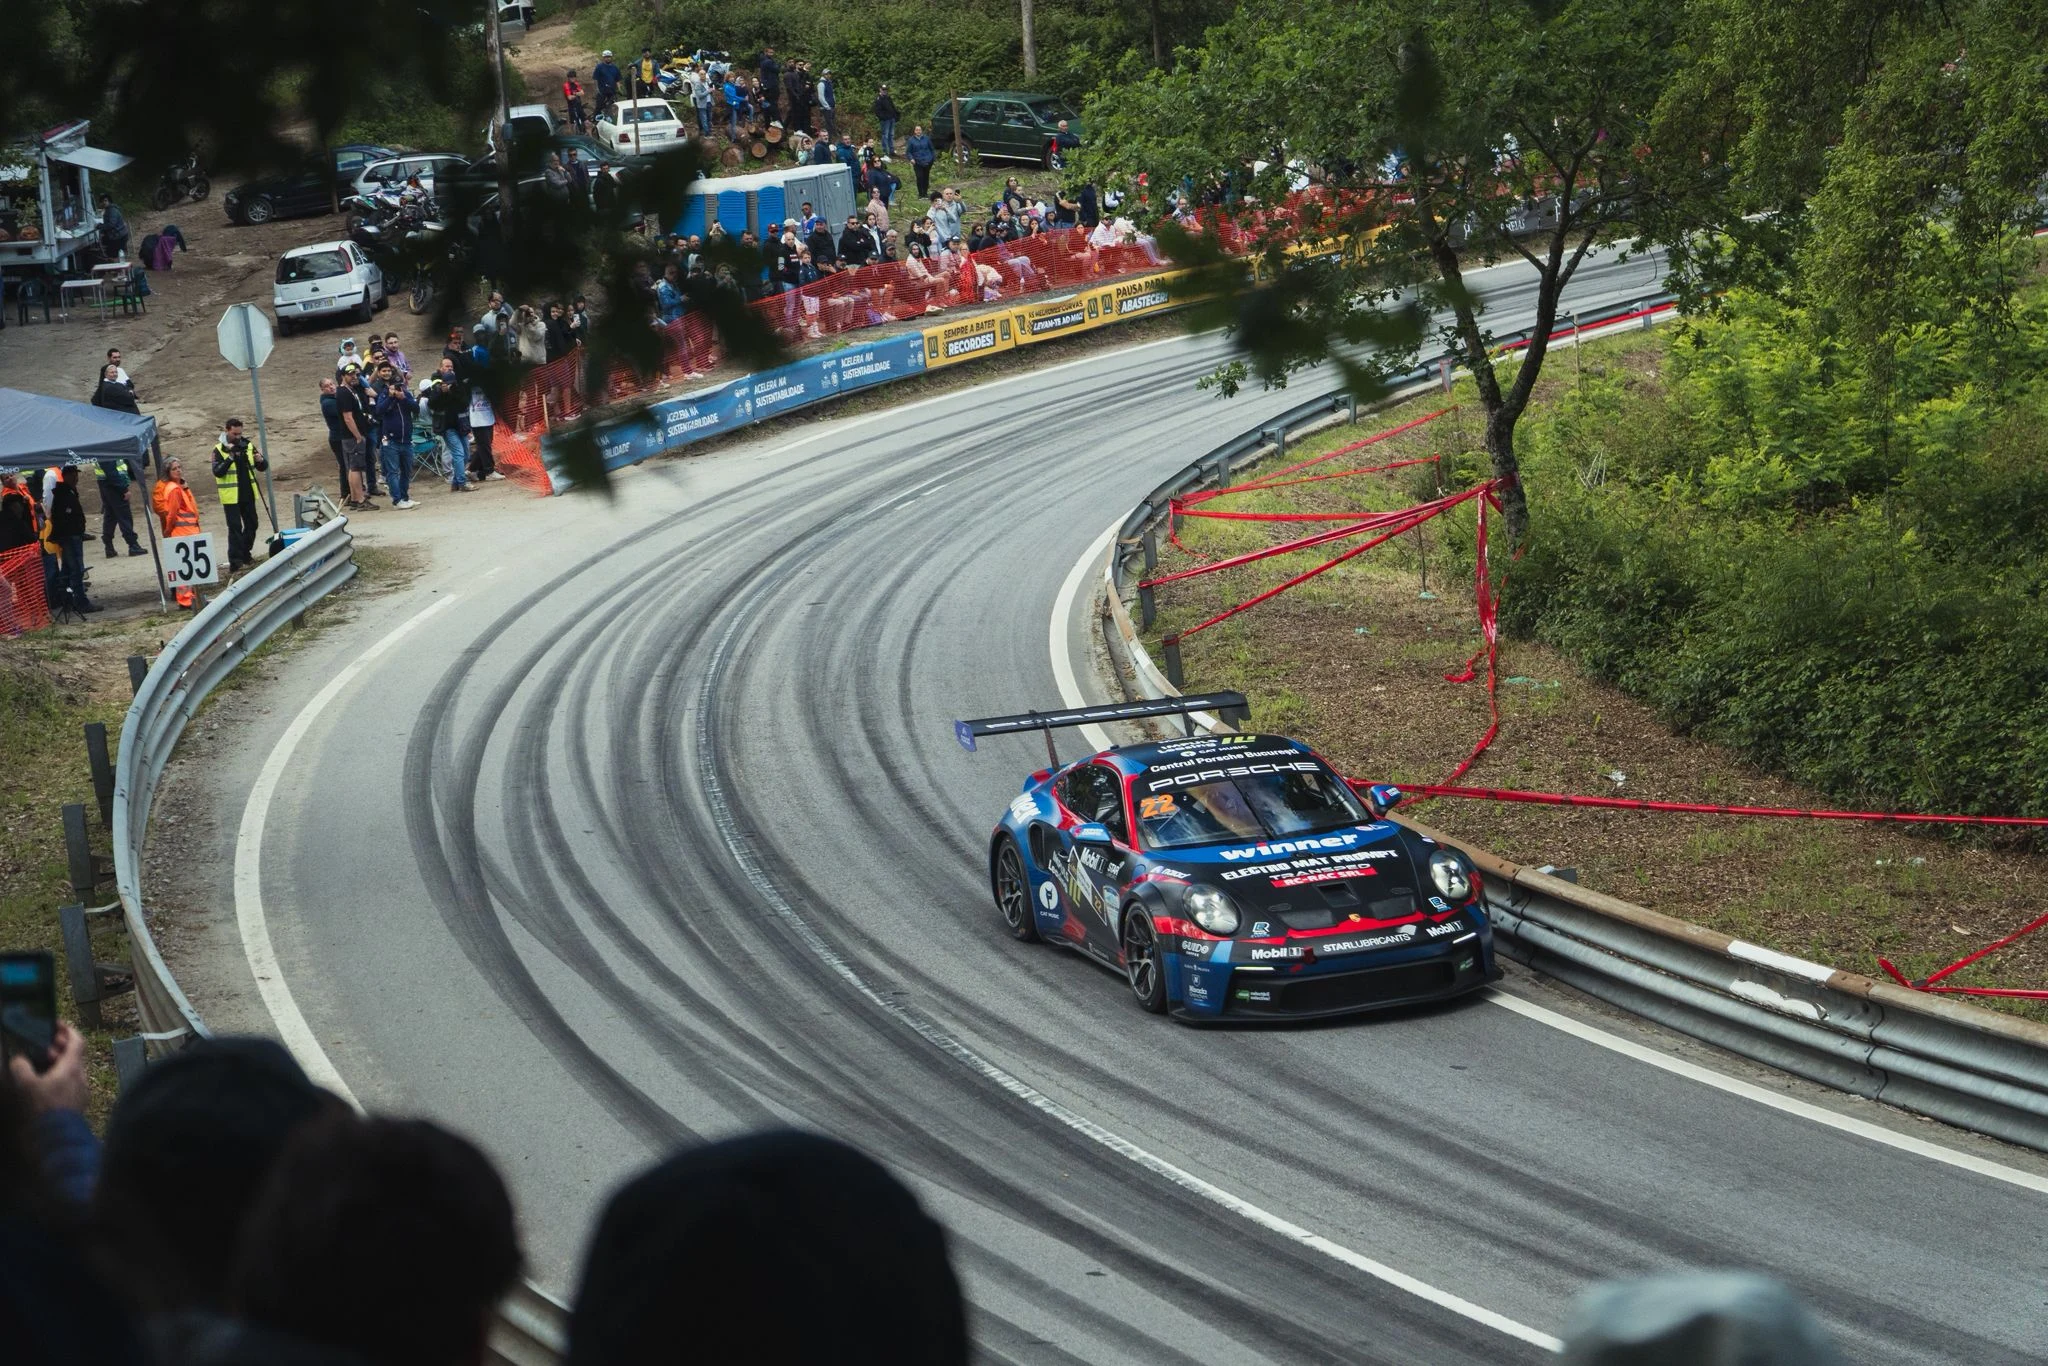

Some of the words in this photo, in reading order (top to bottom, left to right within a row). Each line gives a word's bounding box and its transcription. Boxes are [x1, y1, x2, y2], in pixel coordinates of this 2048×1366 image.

[1116, 283, 1143, 298] PAUSA
[1144, 277, 1166, 291] PARA
[1121, 291, 1168, 313] ABASTECER!
[943, 325, 968, 340] SEMPRE
[969, 323, 974, 334] A
[975, 319, 996, 331] BATER
[948, 332, 994, 356] RECORDES!
[841, 353, 864, 368] ACELERA
[865, 352, 874, 361] NA
[843, 360, 891, 380] SUSTENTABILIDADE
[754, 379, 777, 395] ACELERA
[778, 376, 787, 387] NA
[756, 383, 805, 408] SUSTENTABILIDADE
[689, 405, 699, 417] NA
[667, 412, 719, 437] SUSTENTABILIDADE
[175, 540, 211, 581] 35
[985, 700, 1212, 729] PORSCHE
[1150, 759, 1195, 773] Centrul
[1196, 752, 1244, 765] Porsche
[1149, 762, 1320, 792] PORSCHE
[1140, 793, 1175, 818] 22
[1219, 833, 1358, 861] winner
[1220, 862, 1290, 881] ELECTRO
[1292, 857, 1329, 869] MAT
[1329, 850, 1399, 864] PROMPT
[1283, 871, 1337, 886] RC-RAC
[1337, 870, 1365, 879] SRL
[1425, 922, 1455, 937] Mobil
[1181, 940, 1209, 954] GUIDO
[1251, 947, 1287, 960] Mobil
[1323, 933, 1411, 953] STARLUBRICANTS
